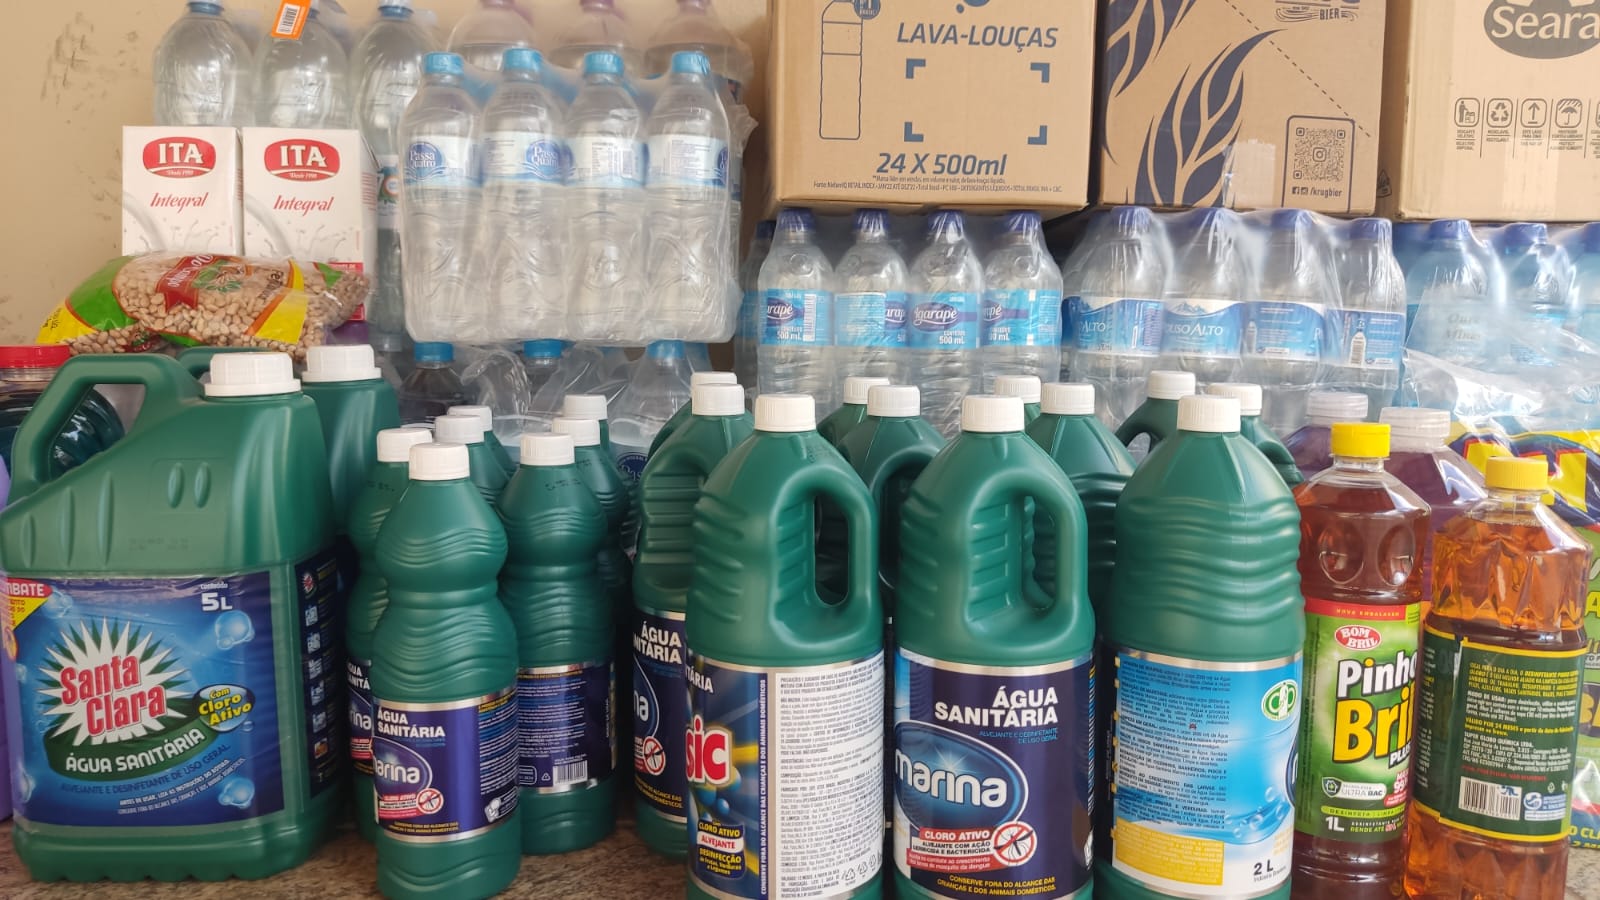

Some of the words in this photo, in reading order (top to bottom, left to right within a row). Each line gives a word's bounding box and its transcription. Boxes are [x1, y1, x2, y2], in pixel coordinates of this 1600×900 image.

[1320, 8, 1340, 20] BIER
[1491, 5, 1600, 39] Seara
[897, 22, 1058, 52] LAVA-LOUÇAS
[158, 143, 204, 164] ITA
[280, 145, 327, 167] ITA
[410, 150, 435, 160] Passa
[876, 153, 906, 174] 24
[910, 153, 930, 174] X
[932, 154, 1007, 175] 500ml
[150, 191, 209, 214] Integral
[273, 194, 335, 217] Integral
[1190, 323, 1224, 336] ALTO
[939, 335, 953, 344] 500
[202, 592, 233, 611] 5L
[641, 620, 682, 647] ÁGUA
[1341, 627, 1370, 639] BOM
[1346, 637, 1378, 649] BRIL
[60, 655, 140, 705] Santa
[210, 688, 230, 699] Com
[992, 686, 1058, 708] ÁGUA
[86, 684, 167, 737] Clara
[198, 694, 242, 715] Cloro
[209, 703, 252, 726] Ativo
[377, 706, 408, 725] ÁGUA
[934, 702, 1058, 727] SANITÁRIA
[378, 721, 446, 738] SANITÁRIA
[66, 752, 112, 773] ÁGUA
[115, 729, 205, 772] SANITÁRIA
[203, 744, 231, 765] GERAL
[895, 748, 1008, 808] marina
[699, 822, 717, 833] CLORO
[719, 827, 741, 837] ATIVO
[1325, 816, 1345, 832] 1L
[701, 835, 735, 849] ALVEJANTE
[924, 831, 956, 841] CLORO
[958, 830, 990, 841] ATIVO
[699, 847, 742, 865] DESINFECÇÃO
[946, 847, 991, 855] BACTERICIDA
[1253, 862, 1263, 875] 2
[1266, 859, 1274, 872] L
[937, 878, 967, 892] CRIANÇAS
[949, 875, 983, 887] CONSERVE
[1015, 878, 1042, 888] ALCANCE
[1043, 876, 1055, 884] DAS
